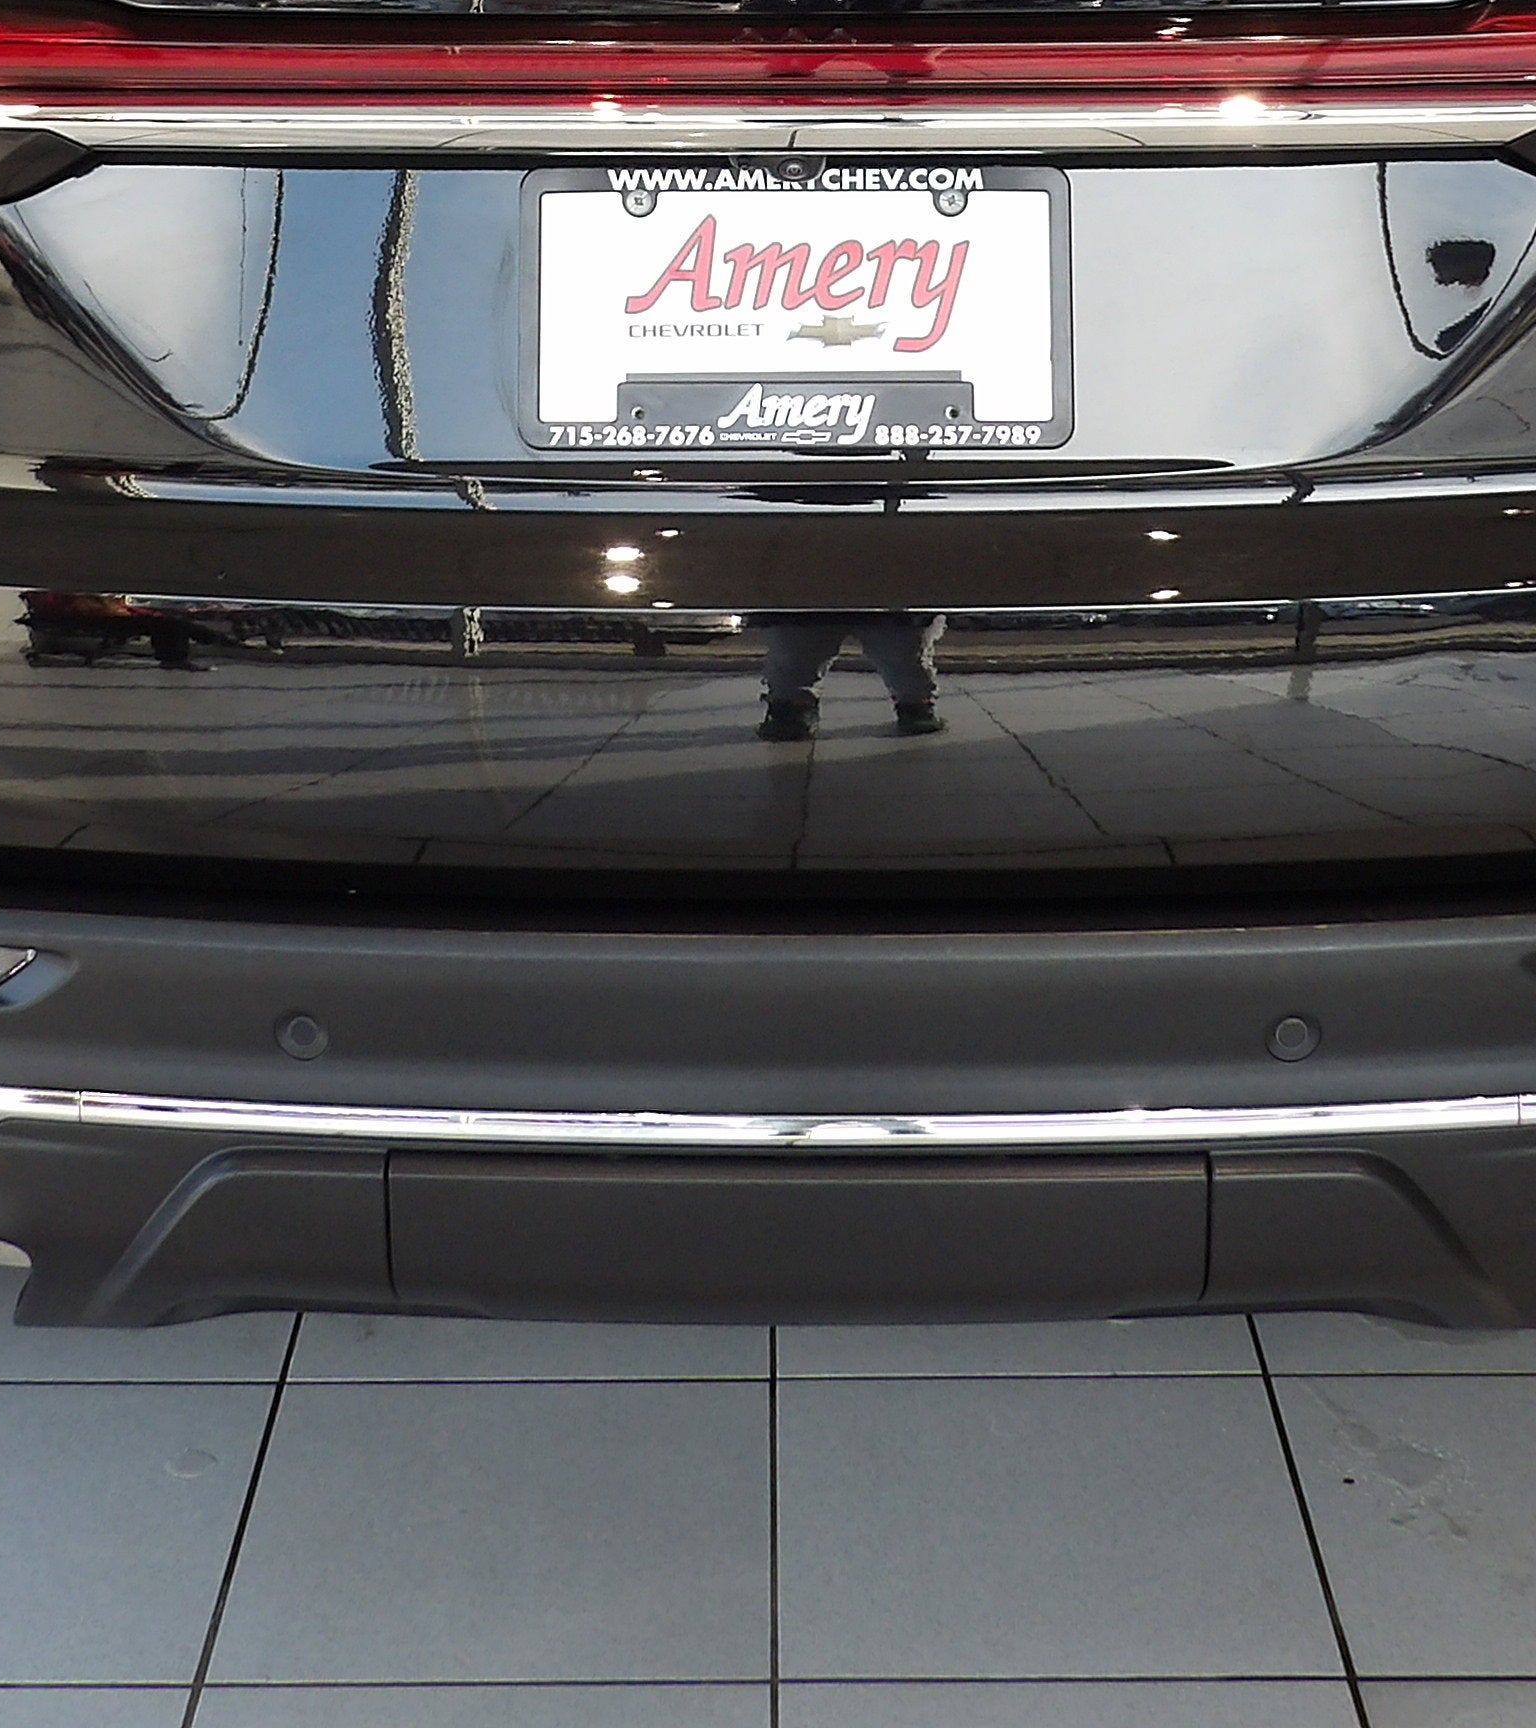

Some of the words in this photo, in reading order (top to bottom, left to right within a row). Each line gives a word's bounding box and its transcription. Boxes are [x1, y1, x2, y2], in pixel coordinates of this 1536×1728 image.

[625, 214, 969, 352] Amery
[628, 323, 764, 338] CHEVROLET
[717, 382, 876, 445] Amery
[549, 425, 715, 446] 715-268-7676
[719, 432, 778, 441] CHEVROLET
[874, 424, 1042, 446] 888-257-7989
